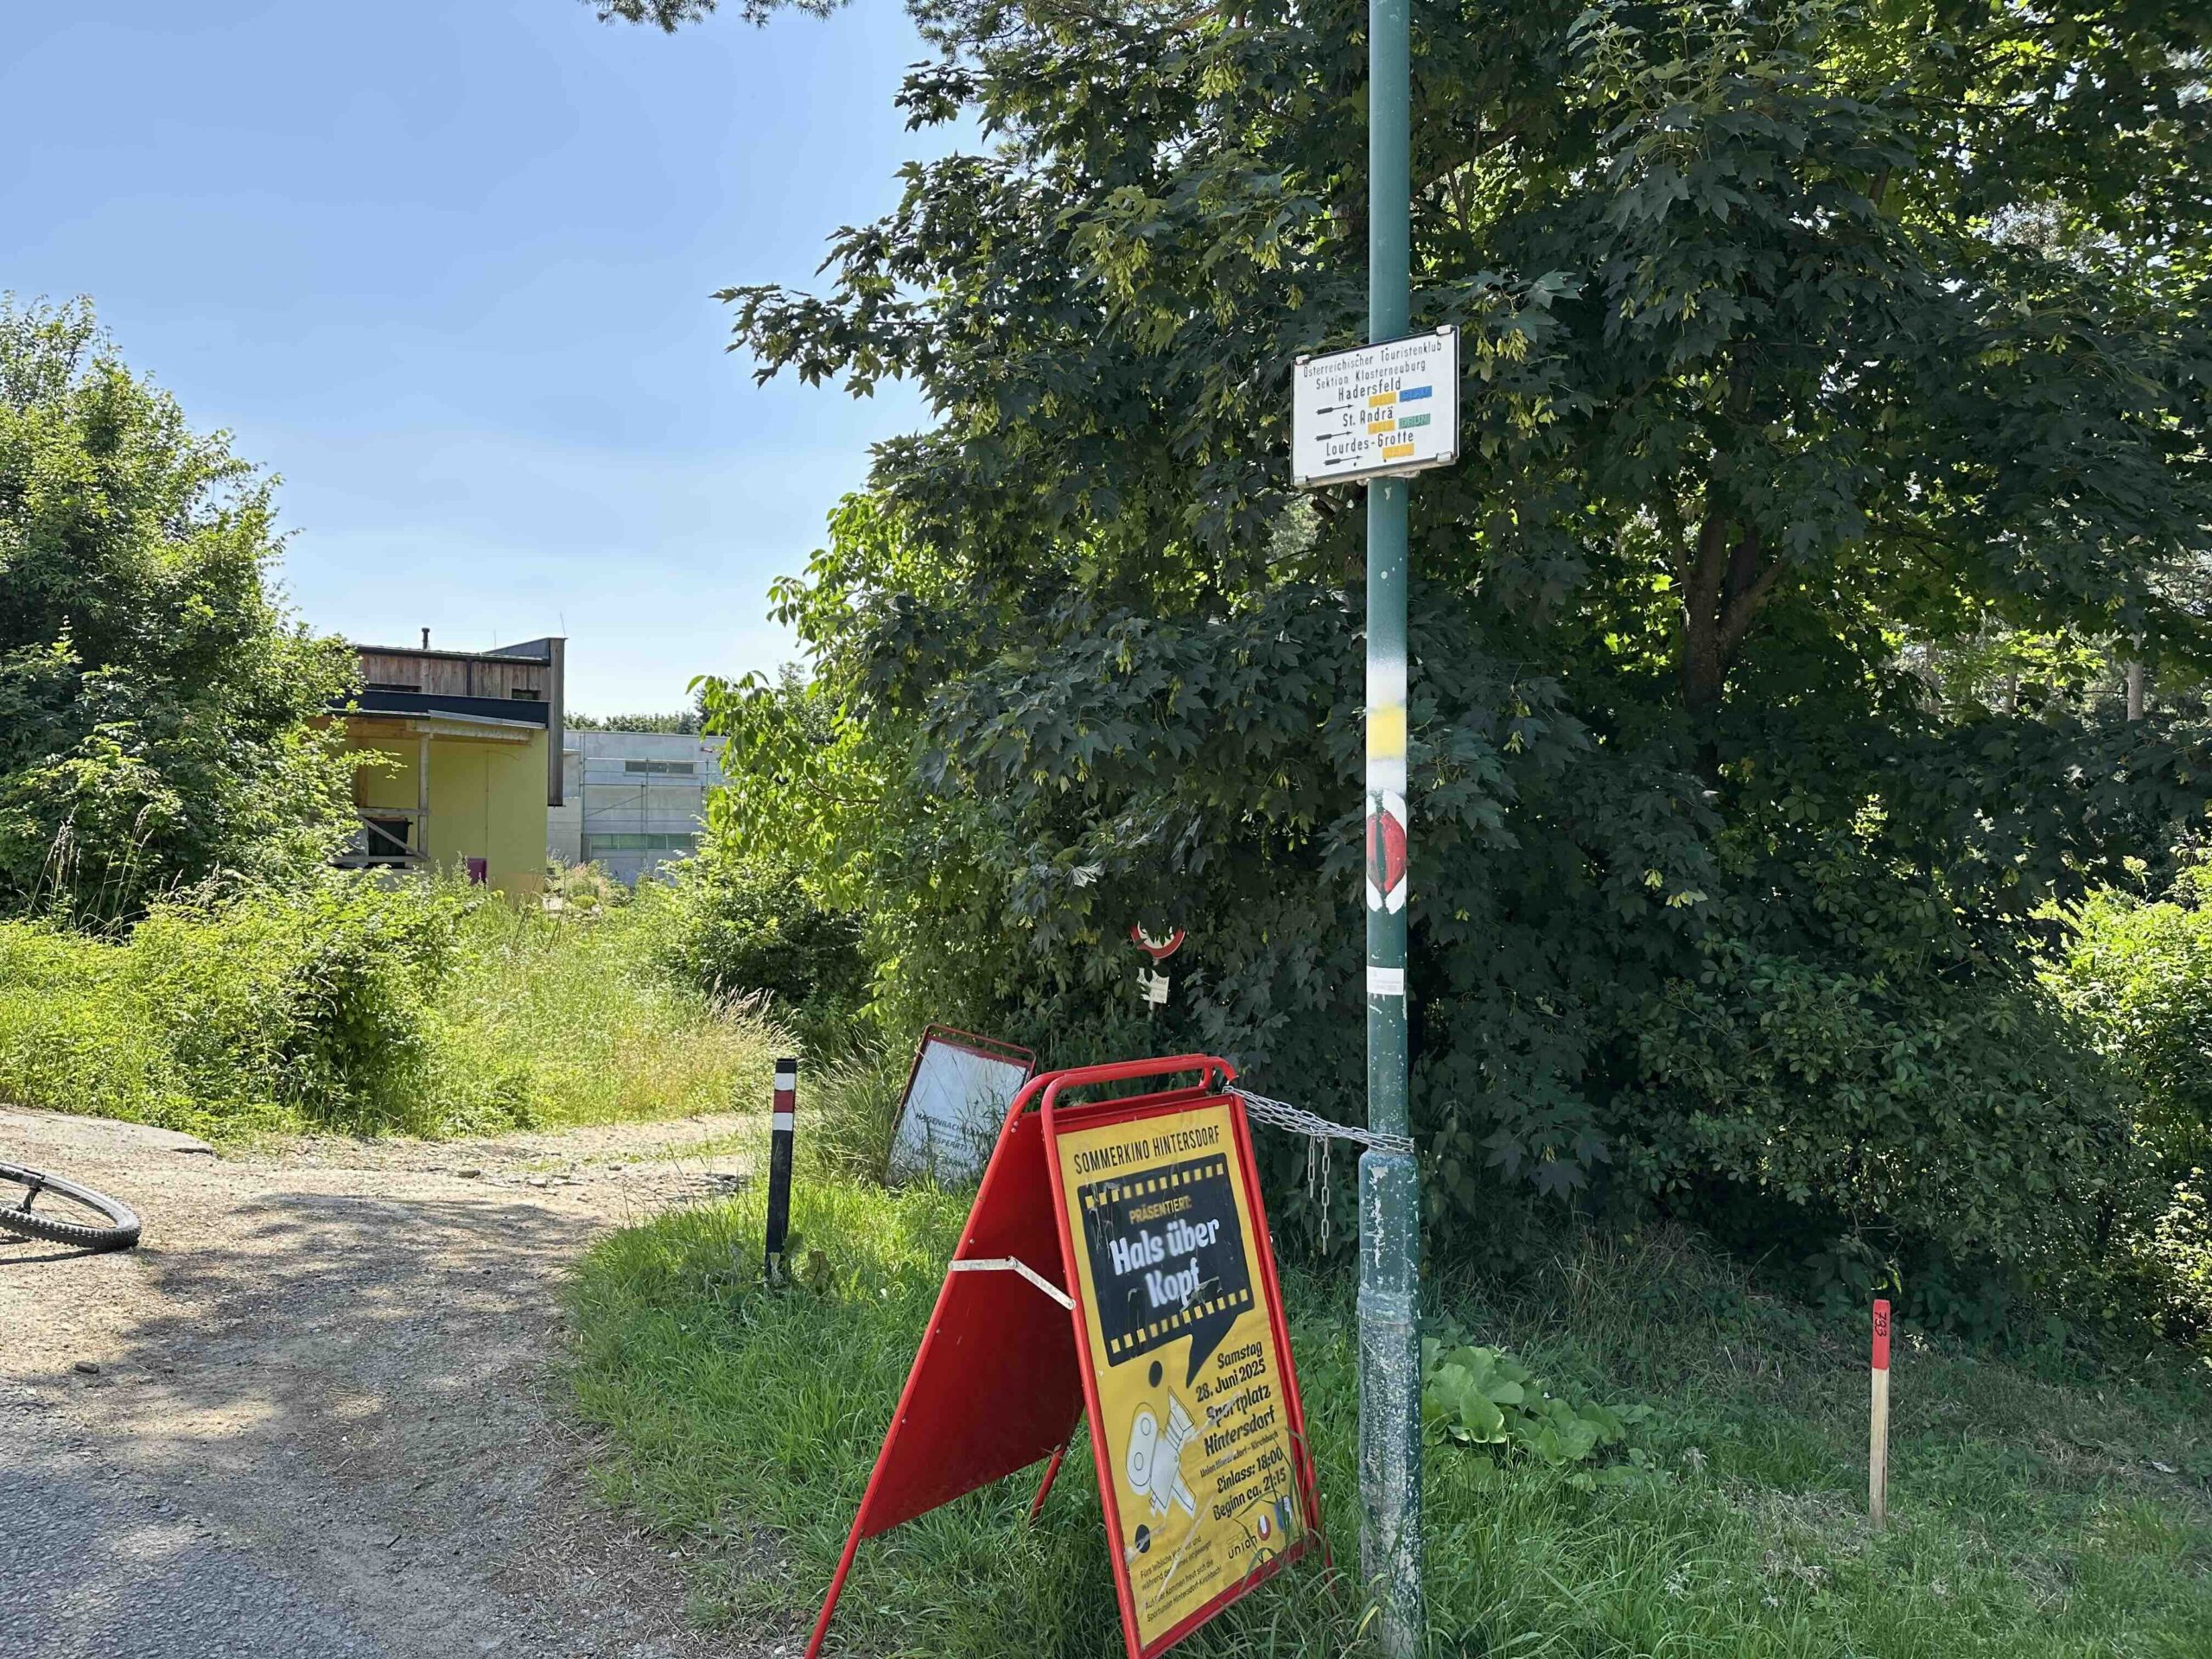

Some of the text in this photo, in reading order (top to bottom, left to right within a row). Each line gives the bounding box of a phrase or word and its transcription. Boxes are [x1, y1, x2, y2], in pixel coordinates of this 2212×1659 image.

[1303, 340, 1442, 378] Österreichischer Touristenklub
[1316, 375, 1349, 390] Sektion
[1338, 378, 1402, 402] Hadersfeld
[1343, 413, 1356, 427] St.
[1360, 406, 1394, 424] Andrä
[1326, 431, 1414, 456] Lourdes-Grotte
[1074, 1125, 1220, 1174] SOMMERKINO HINTERSDORF
[1128, 1196, 1192, 1224] PRÄSENTIERT:
[1109, 1217, 1220, 1275] Hals über
[1144, 1256, 1201, 1308] Kopf
[1217, 1341, 1263, 1370] Samstag
[1196, 1357, 1267, 1402] 28. Juni 2025
[1206, 1384, 1272, 1427] Sportplatz
[1205, 1405, 1276, 1457] Hintersdorf
[1217, 1446, 1283, 1494] Einlass: 18:00
[1212, 1466, 1287, 1521] Beginn ca. 21:15
